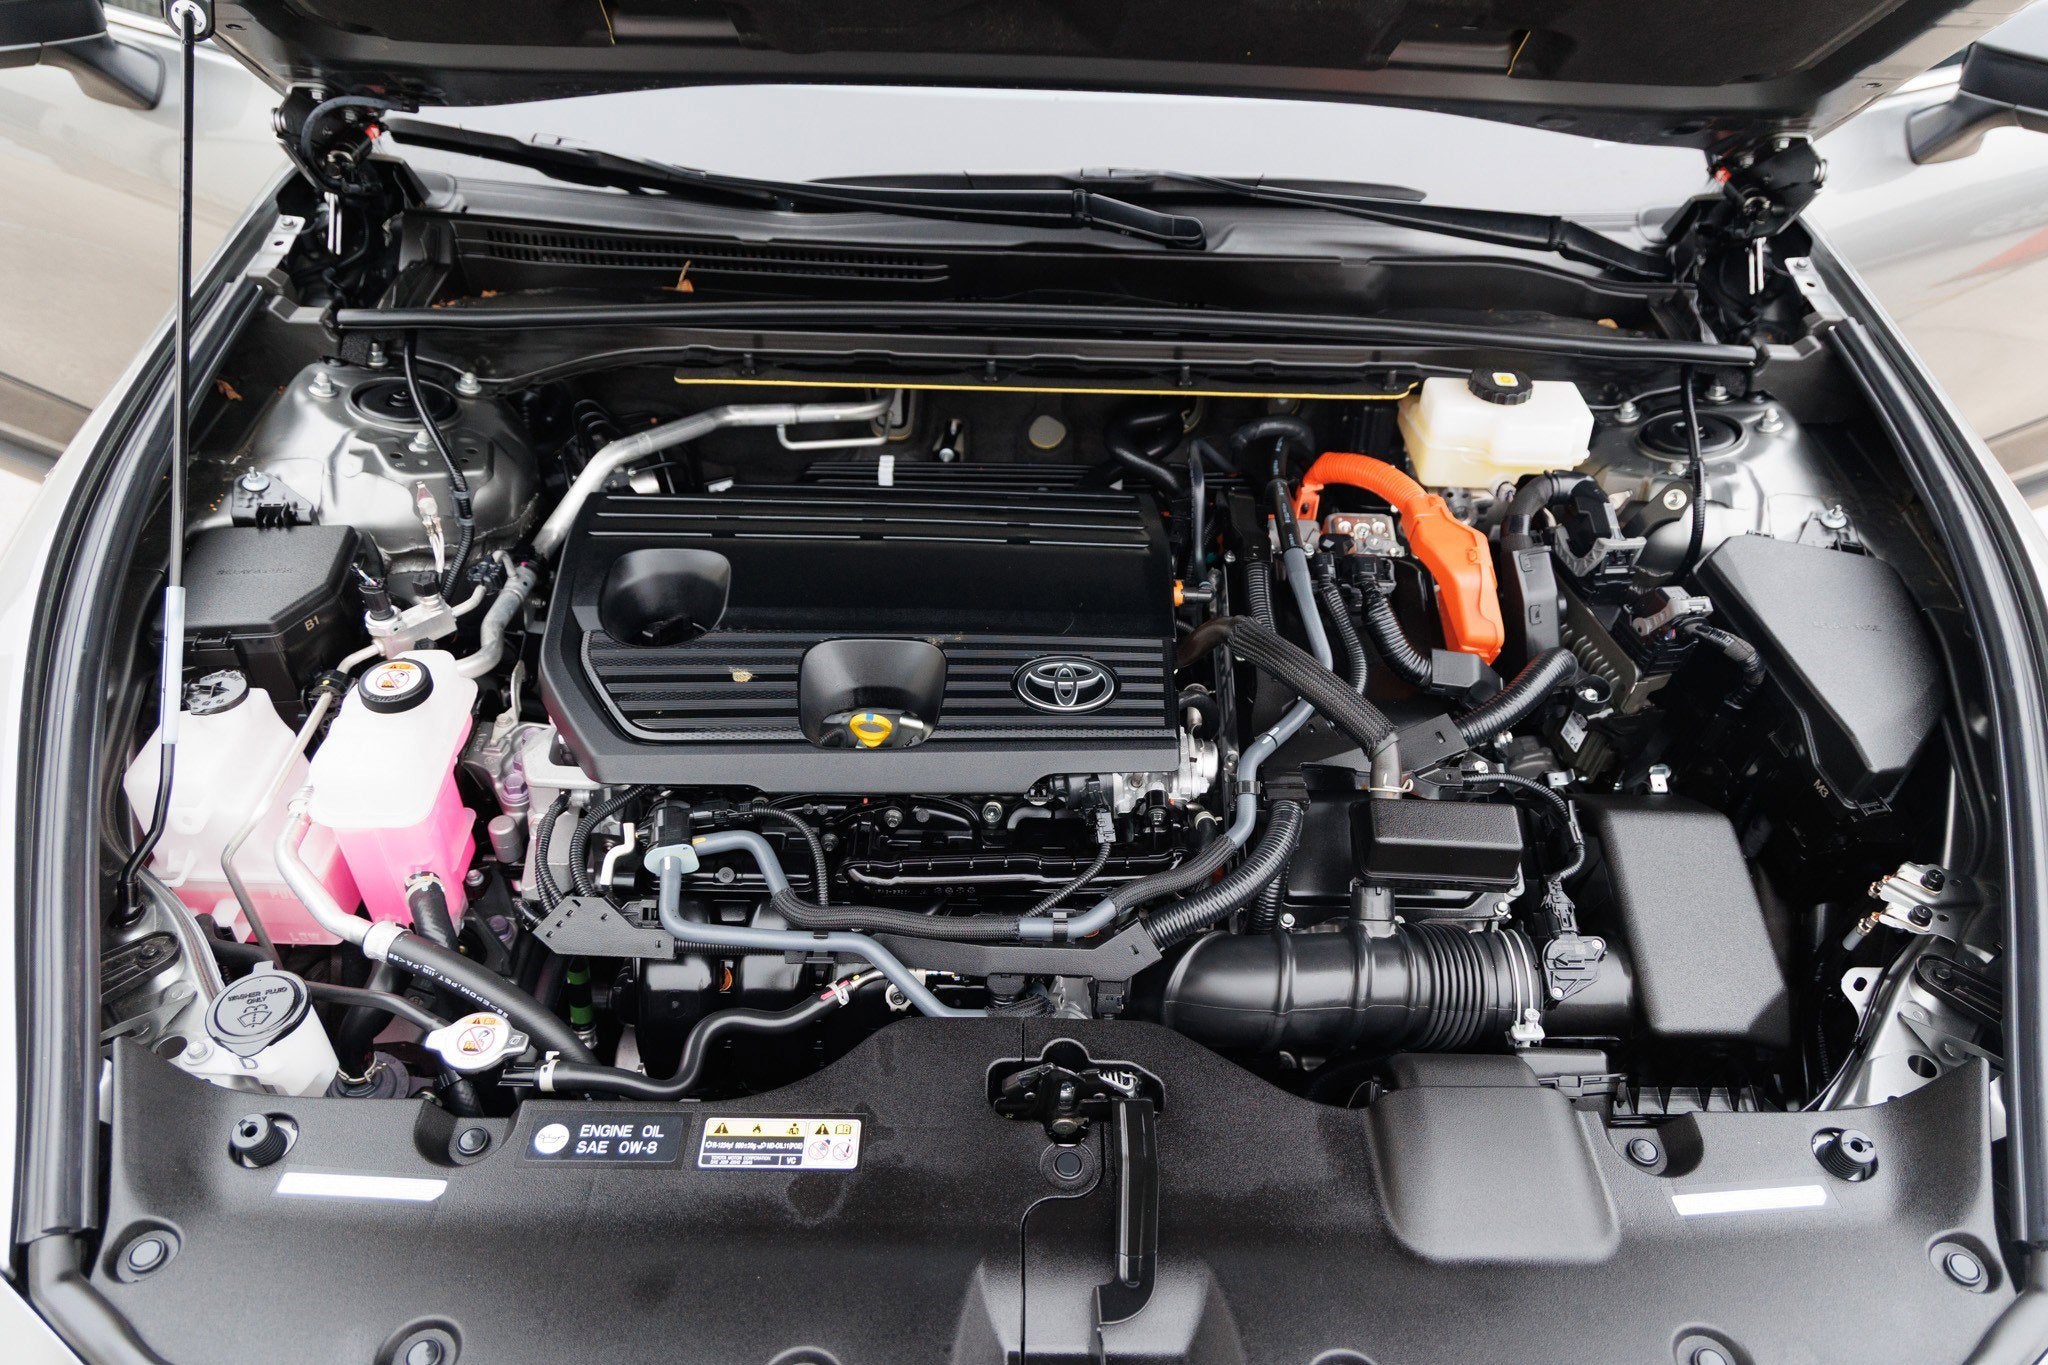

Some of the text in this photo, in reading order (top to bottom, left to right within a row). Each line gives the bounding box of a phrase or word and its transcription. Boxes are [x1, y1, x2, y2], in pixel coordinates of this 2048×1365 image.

[304, 615, 321, 632] B1
[1813, 778, 1830, 798] M3
[227, 986, 288, 1002] WASHER FLUID
[246, 996, 267, 1004] ONLY
[579, 1124, 665, 1138] ENGINE OIL
[575, 1141, 658, 1155] SAE 0W-8
[786, 1157, 797, 1165] VC
